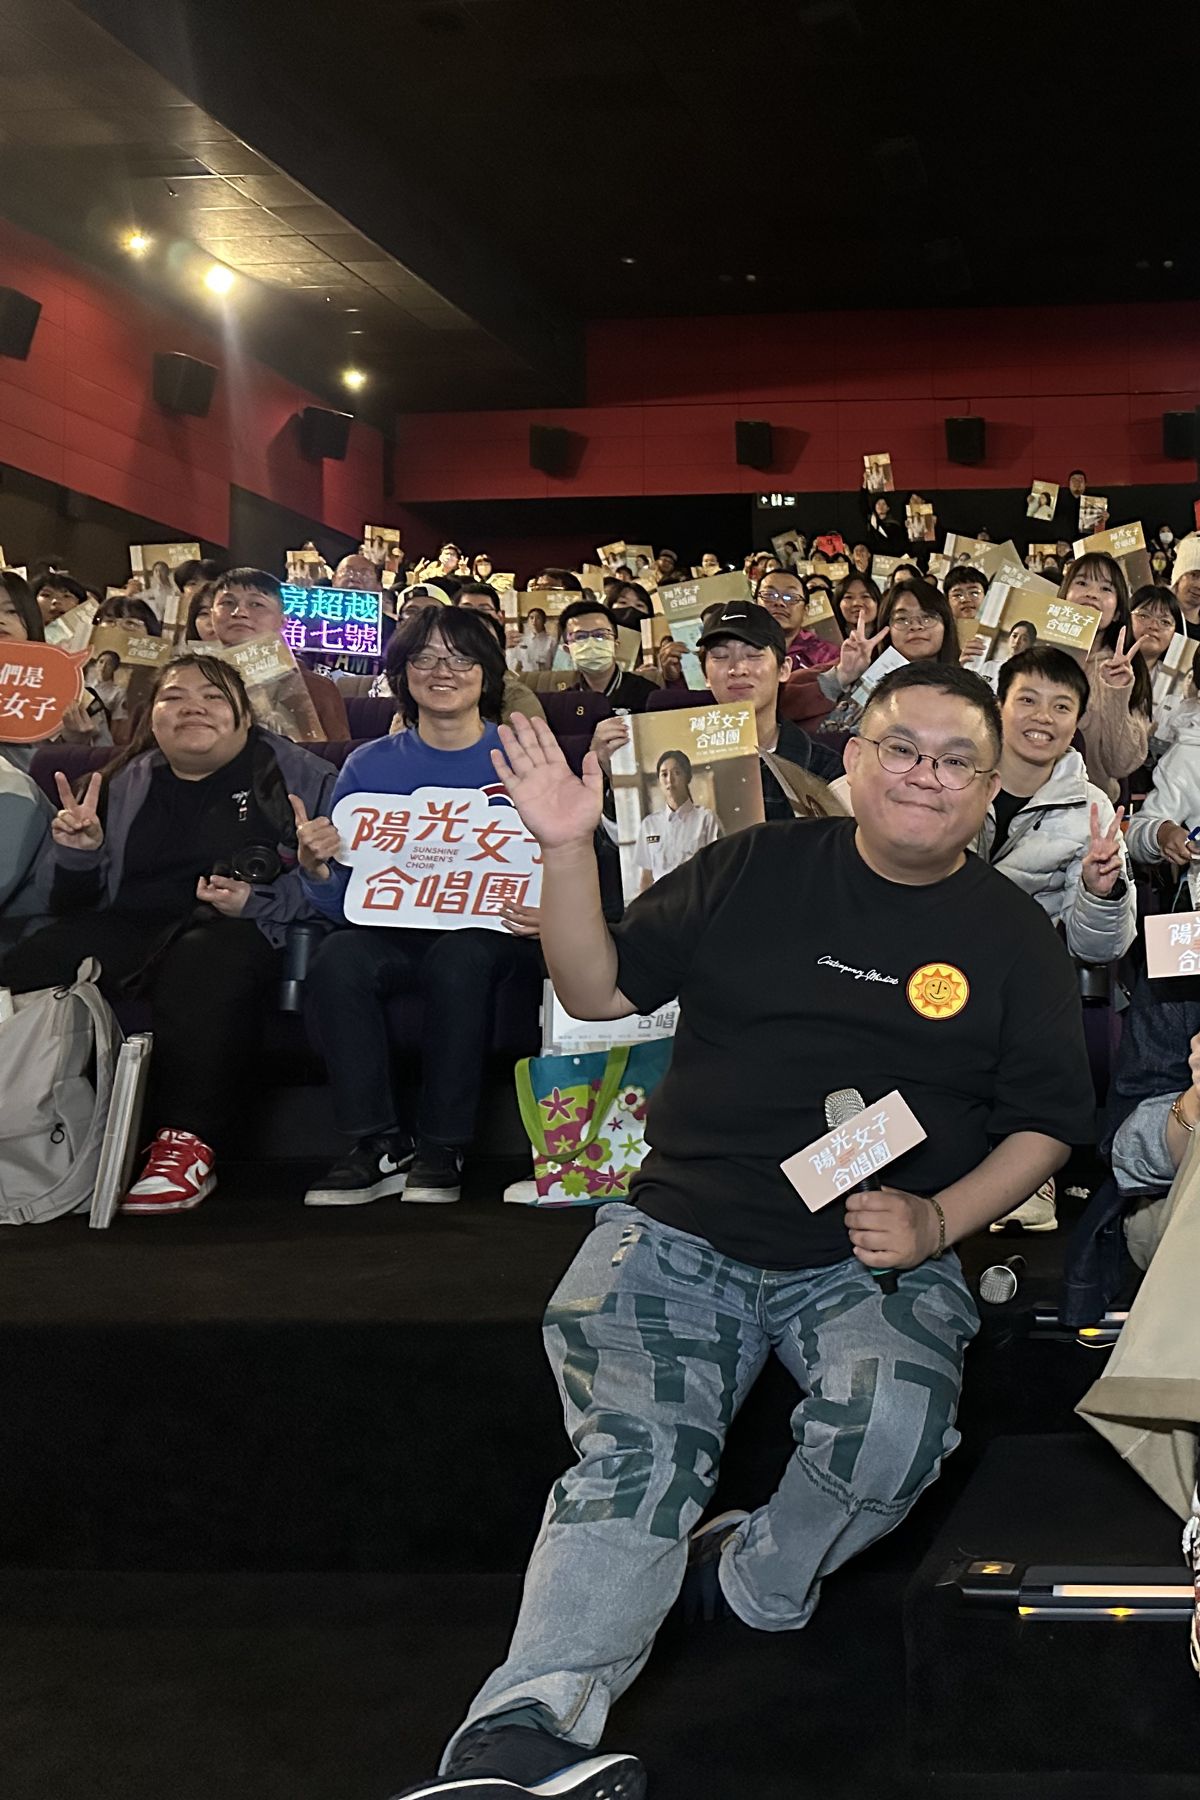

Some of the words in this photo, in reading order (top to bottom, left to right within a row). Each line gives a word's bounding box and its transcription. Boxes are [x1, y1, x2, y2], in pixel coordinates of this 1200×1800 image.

[0, 692, 57, 721] 女子
[689, 710, 750, 732] 陽光女子
[696, 728, 740, 749] 合唱團
[409, 854, 454, 863] WOMEN'S
[412, 845, 460, 856] SUNSHINE
[405, 861, 435, 870] CHOIR
[362, 865, 533, 916] 合唱團
[808, 1111, 890, 1175] 陽光女子
[832, 1139, 892, 1191] 合唱團
